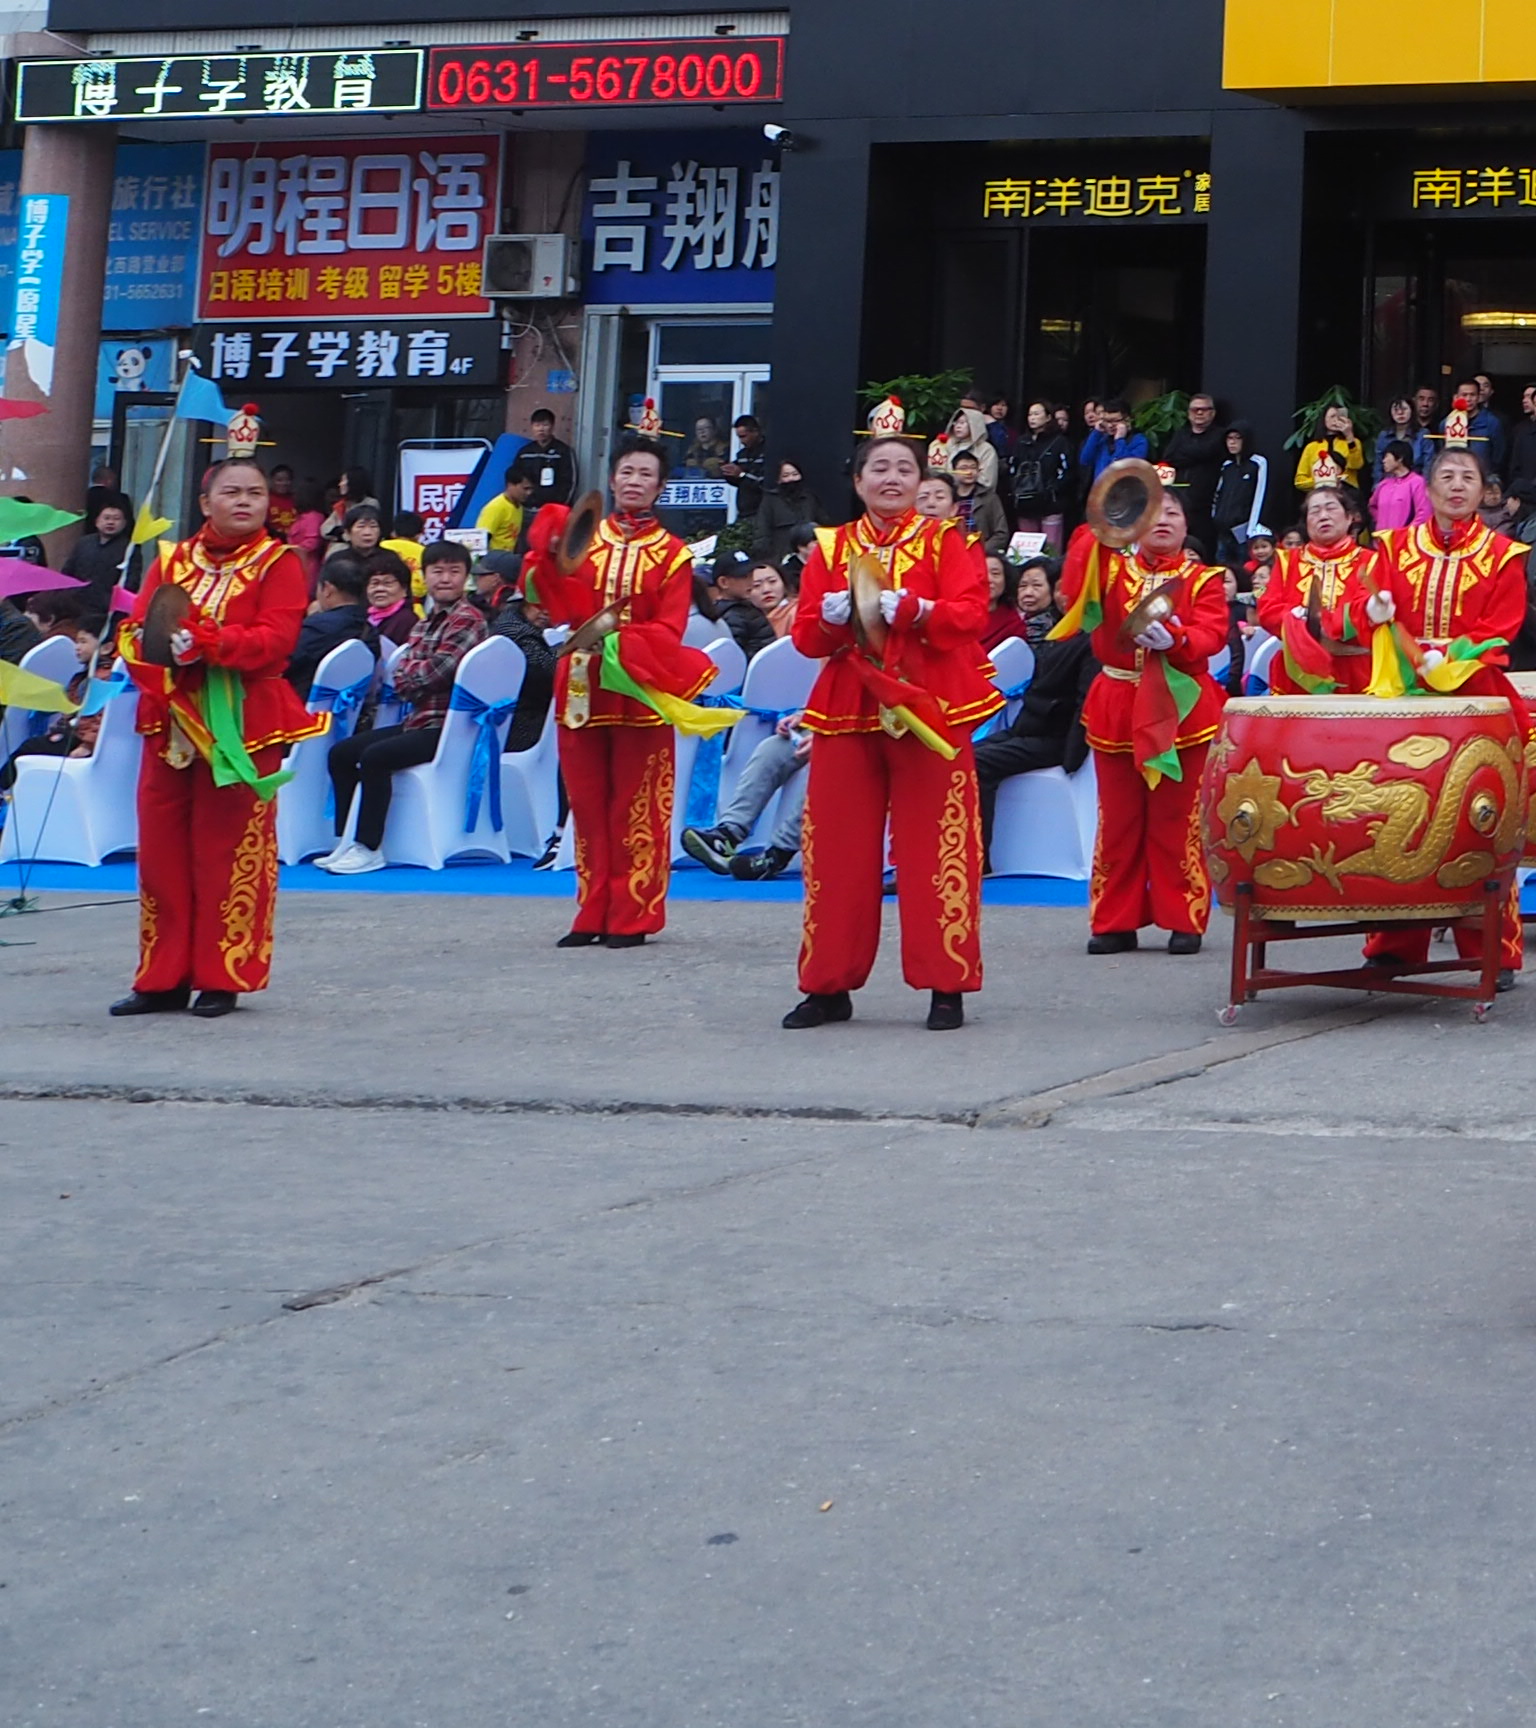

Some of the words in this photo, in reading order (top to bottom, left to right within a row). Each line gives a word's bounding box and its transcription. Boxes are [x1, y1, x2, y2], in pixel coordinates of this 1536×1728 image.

[438, 53, 762, 103] 0631-5678000
[207, 151, 489, 258] 明程日语
[982, 174, 1181, 218] 南洋迪克
[129, 220, 192, 241] SERVICE
[209, 268, 310, 302] 日语培训
[316, 265, 369, 300] 考级
[379, 264, 431, 299] 留学
[210, 329, 450, 380] 博子学教育
[449, 357, 474, 374] 4F
